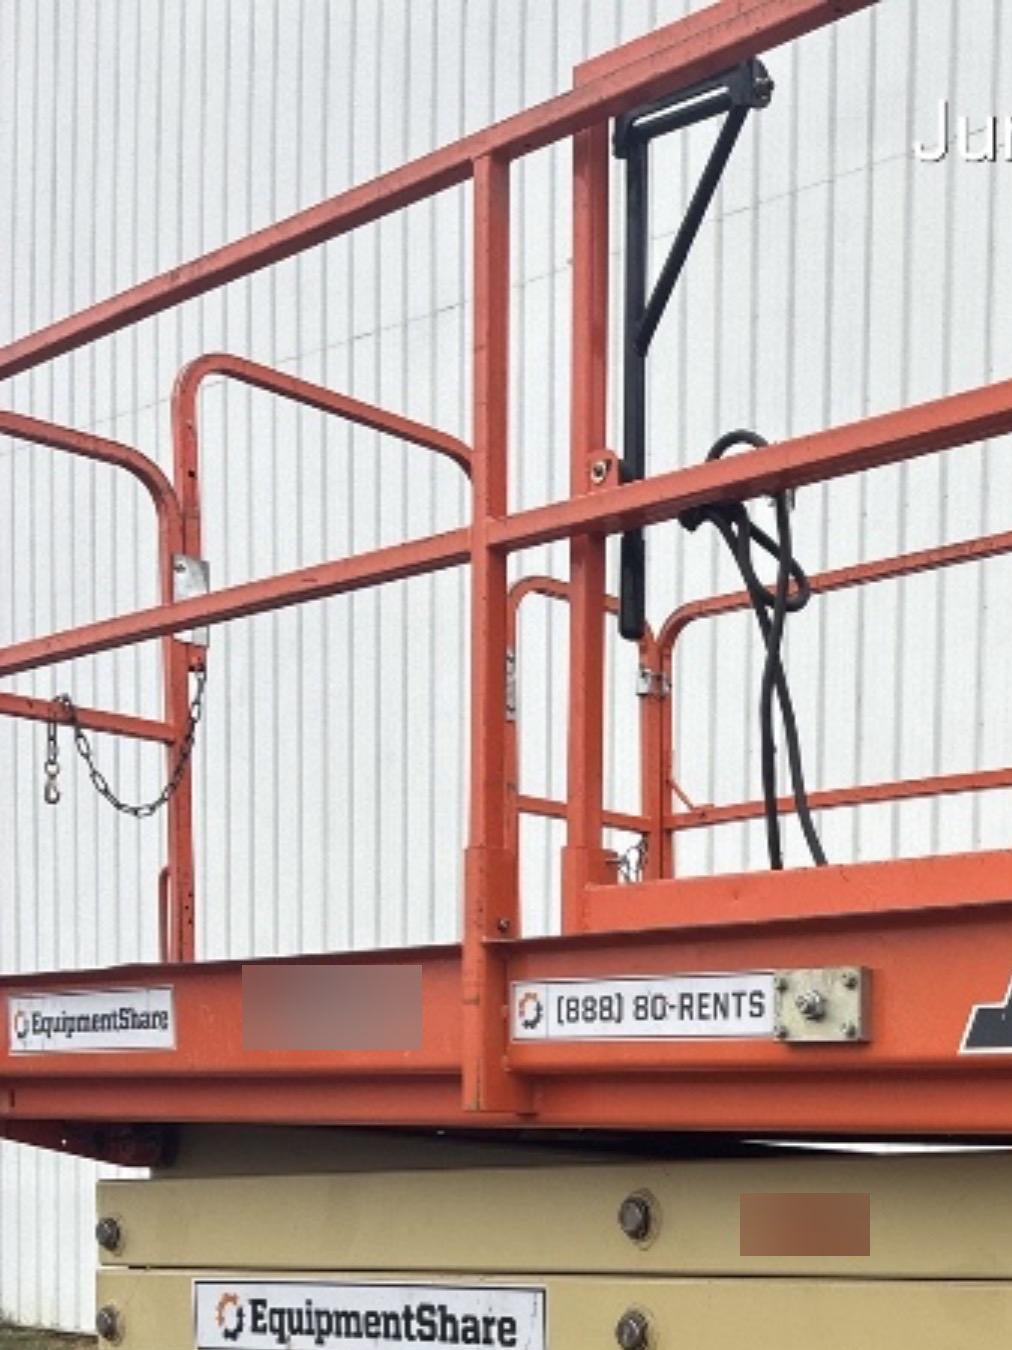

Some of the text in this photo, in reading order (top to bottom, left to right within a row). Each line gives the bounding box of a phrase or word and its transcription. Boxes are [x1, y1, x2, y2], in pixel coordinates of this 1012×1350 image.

[31, 1006, 169, 1038] EquipmentShare
[556, 989, 766, 1025] (888) 80-RENTS
[249, 1298, 518, 1348] EquipmentShare
